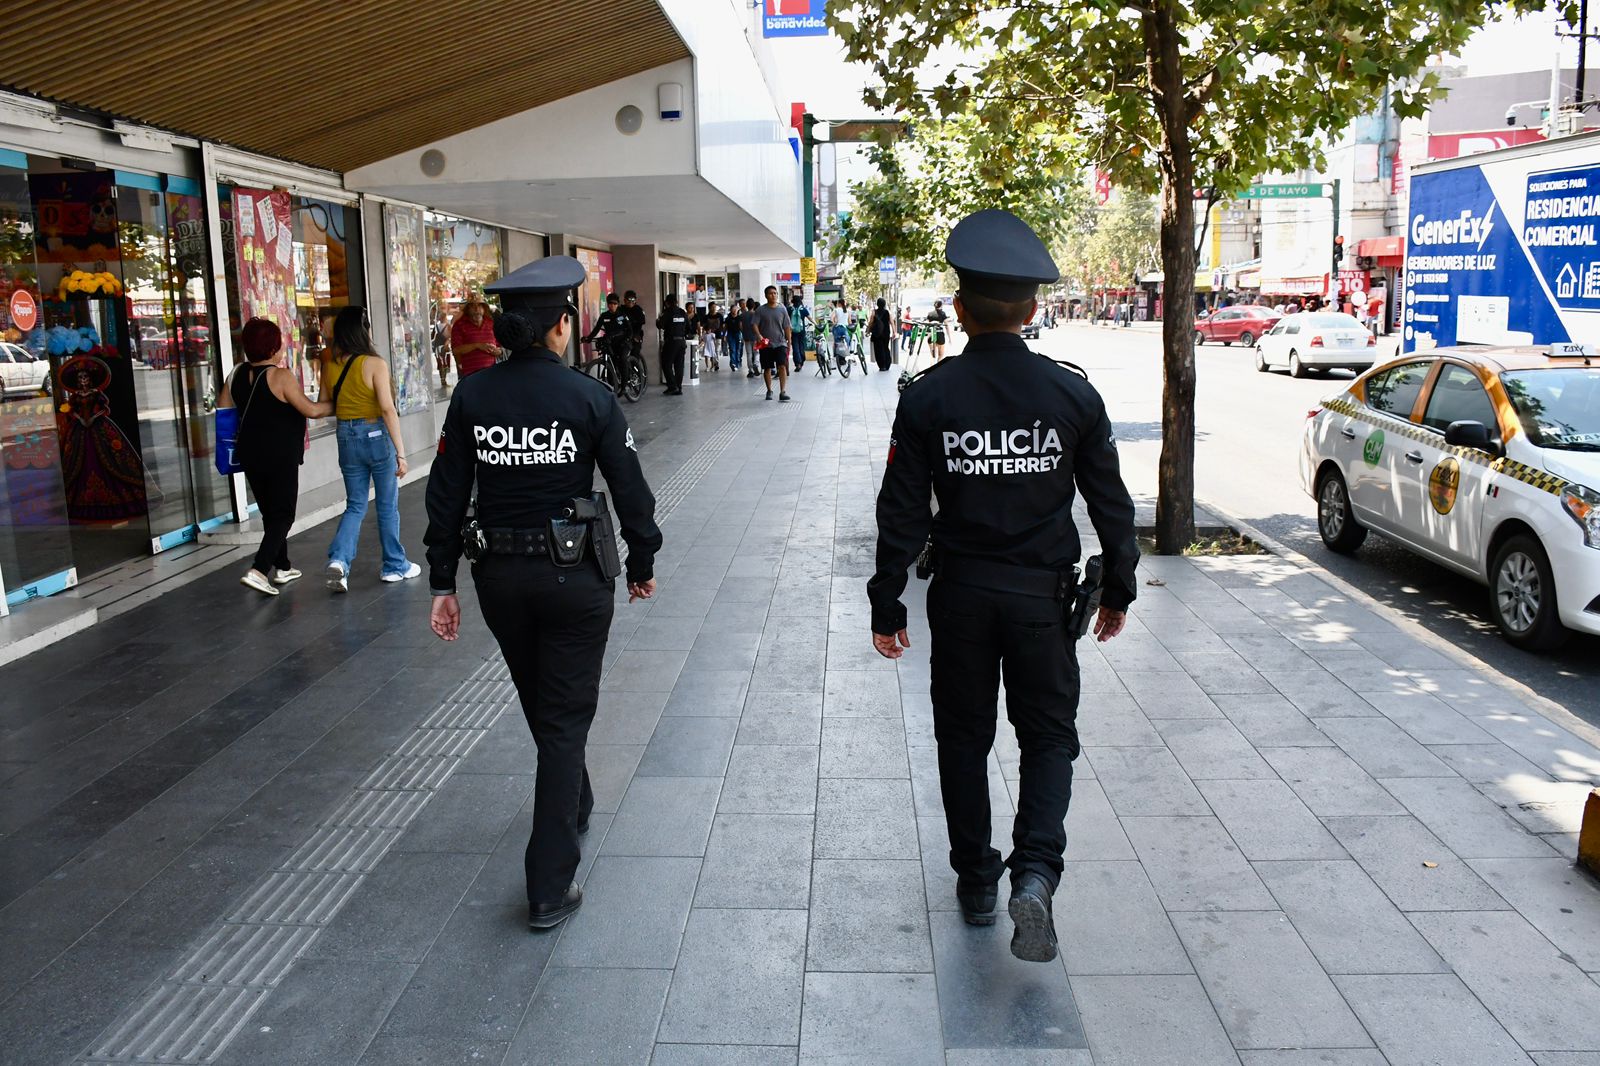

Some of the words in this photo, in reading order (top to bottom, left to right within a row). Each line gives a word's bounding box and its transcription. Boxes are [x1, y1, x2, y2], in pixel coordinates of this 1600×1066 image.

[766, 16, 826, 29] benavides
[1260, 187, 1274, 196] DE
[1278, 187, 1308, 195] MAYO
[1412, 210, 1483, 246] GenerEx
[1525, 224, 1597, 247] COMERCIAL
[1408, 256, 1464, 270] GENERADORES
[1464, 255, 1477, 270] DE
[1477, 254, 1496, 270] LUZ
[1338, 271, 1365, 279] EMATE
[473, 420, 577, 452] POLICÍA
[942, 420, 1063, 456] POLICÍA
[476, 449, 576, 466] MONTERREY
[946, 455, 1063, 475] MONTERREY
[1435, 466, 1457, 483] TAXI
